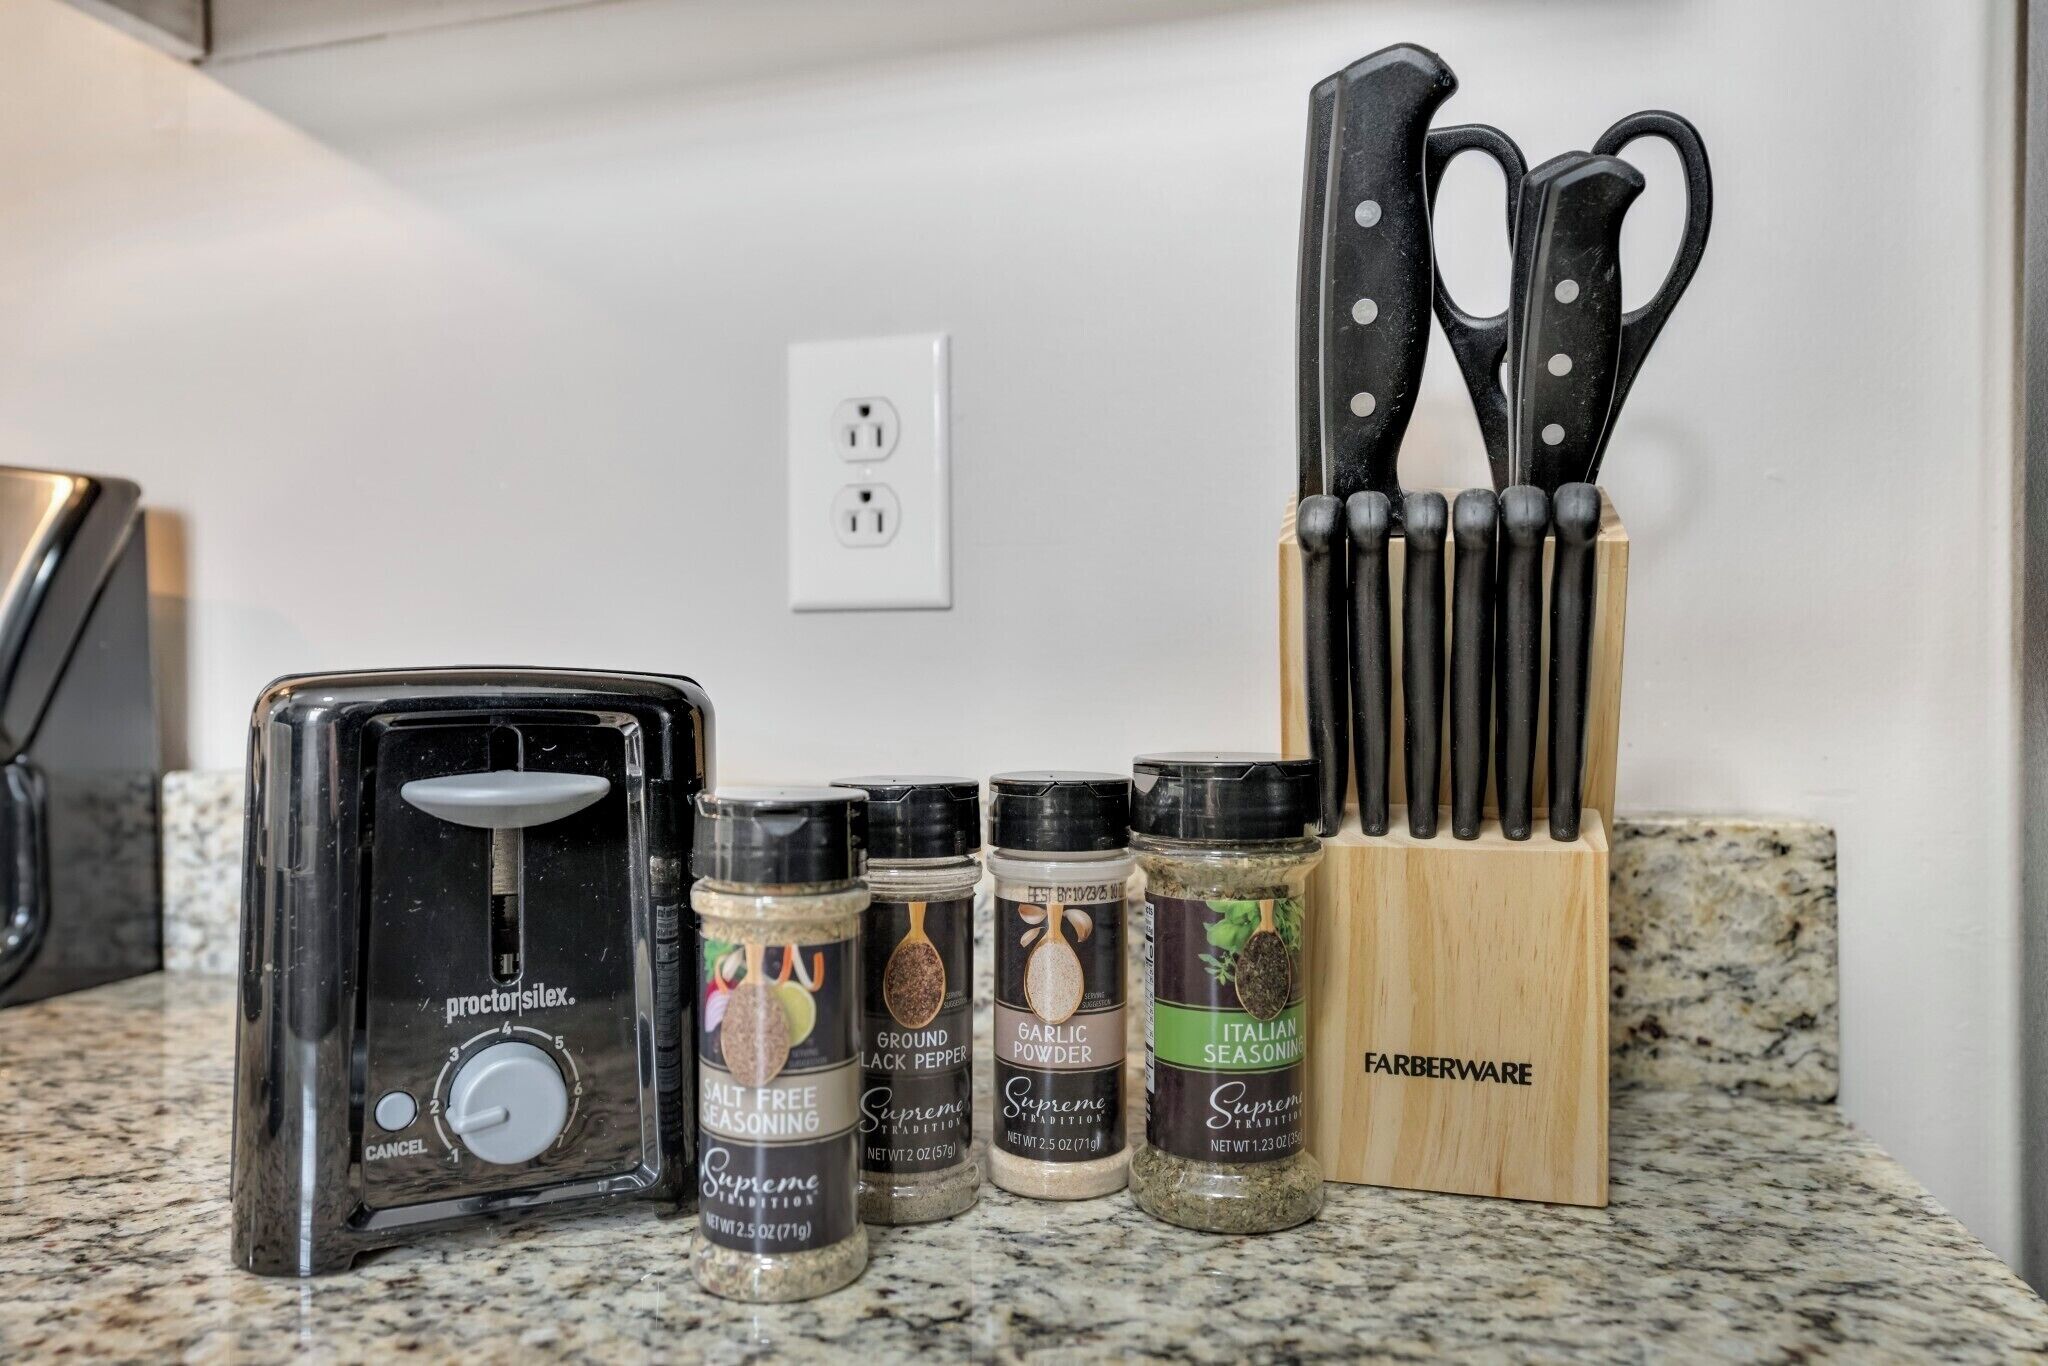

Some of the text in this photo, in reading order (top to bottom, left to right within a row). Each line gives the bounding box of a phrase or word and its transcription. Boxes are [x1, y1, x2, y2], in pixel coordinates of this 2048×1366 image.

[502, 1021, 512, 1035] 4
[877, 1029, 948, 1049] GROUND
[1018, 1022, 1087, 1043] GARLIC
[1224, 1017, 1296, 1042] ITALIAN
[555, 1036, 564, 1049] 5
[1014, 1041, 1092, 1063] POWDER
[1204, 1035, 1304, 1064] SEASONING
[450, 1047, 459, 1061] 3
[860, 1045, 967, 1070] LACK PEPPER
[1365, 1052, 1532, 1086] FARBERWARE
[574, 1083, 583, 1095] 6
[704, 1078, 817, 1110] SALT FREE
[1003, 1076, 1105, 1118] Supreme
[430, 1101, 440, 1113] 2
[703, 1101, 820, 1134] SEASONING
[859, 1086, 963, 1133] Supreme
[1021, 1112, 1102, 1125] TRADITION
[365, 1139, 428, 1161] CANCEL
[867, 1141, 956, 1162] NET WT 2 OZ (57g)
[1007, 1130, 1100, 1152] NET WT 2.5 OZ (71g)
[1211, 1129, 1303, 1152] NET WT 1.23 OZ (35g
[449, 1150, 459, 1162] 1
[703, 1147, 819, 1198] Supreme
[706, 1211, 812, 1241] NET WT 2.5 OZ (71g)
